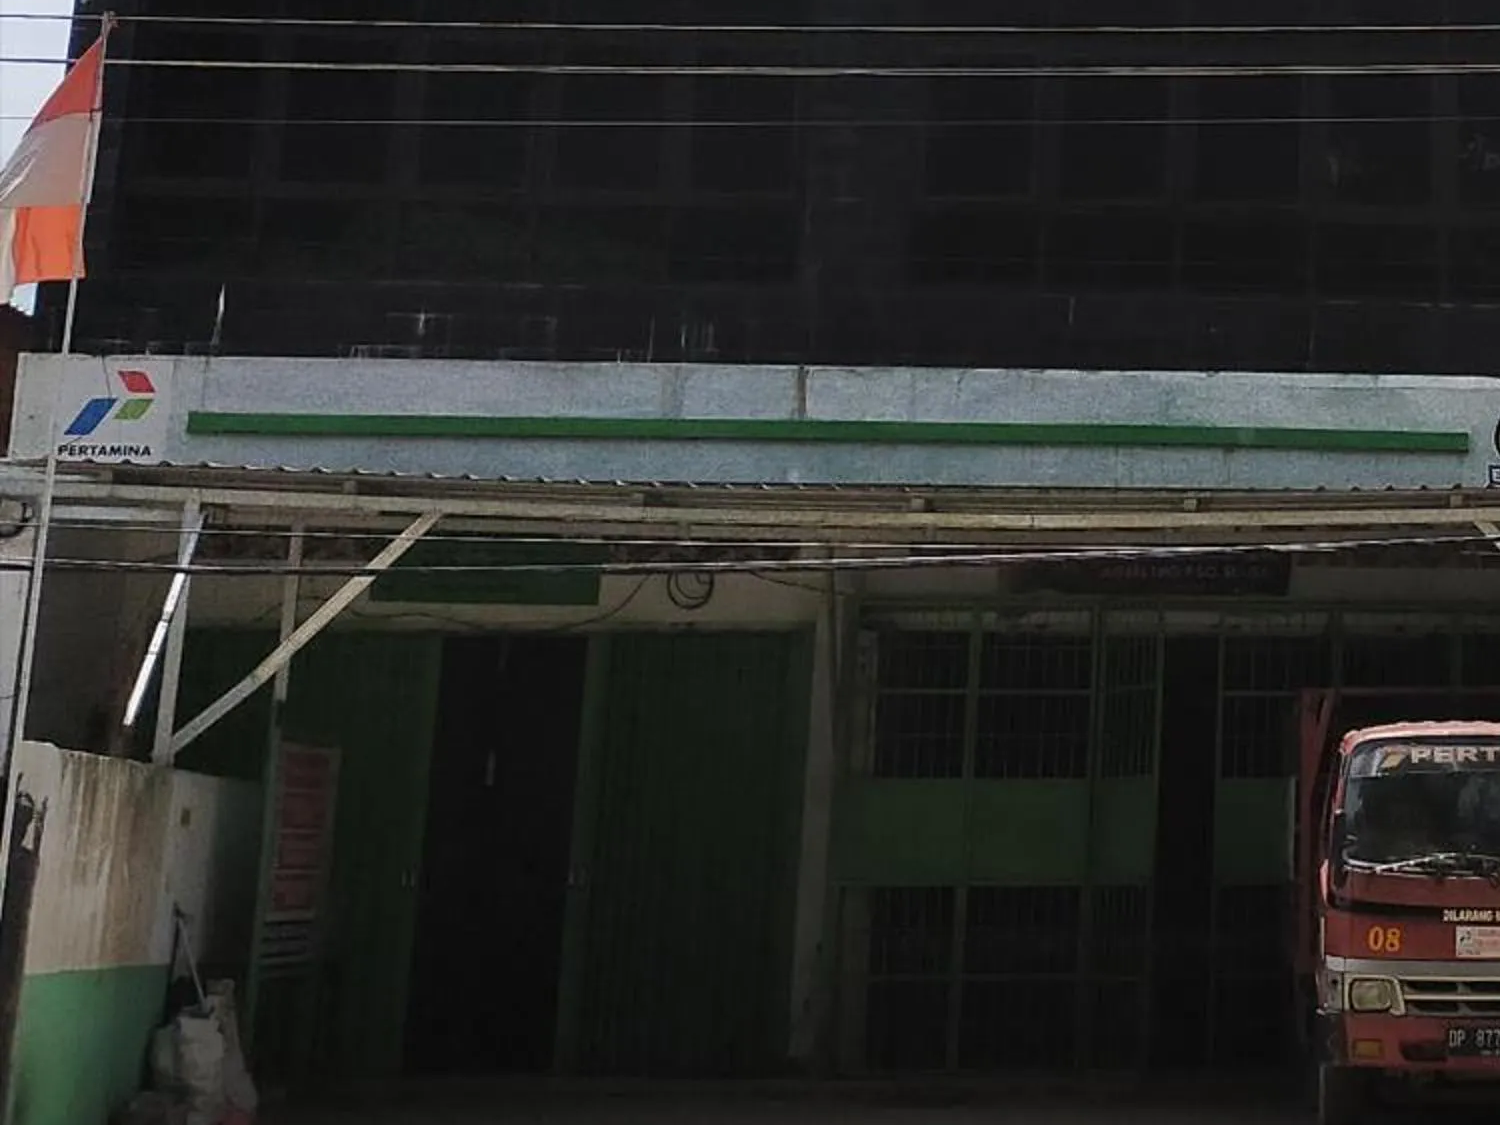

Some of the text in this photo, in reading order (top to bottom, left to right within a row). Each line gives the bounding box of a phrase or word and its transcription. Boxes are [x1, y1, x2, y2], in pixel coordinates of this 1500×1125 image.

[57, 444, 152, 457] PERTAMINA
[1367, 926, 1400, 952] 08
[1449, 1028, 1466, 1048] DP
